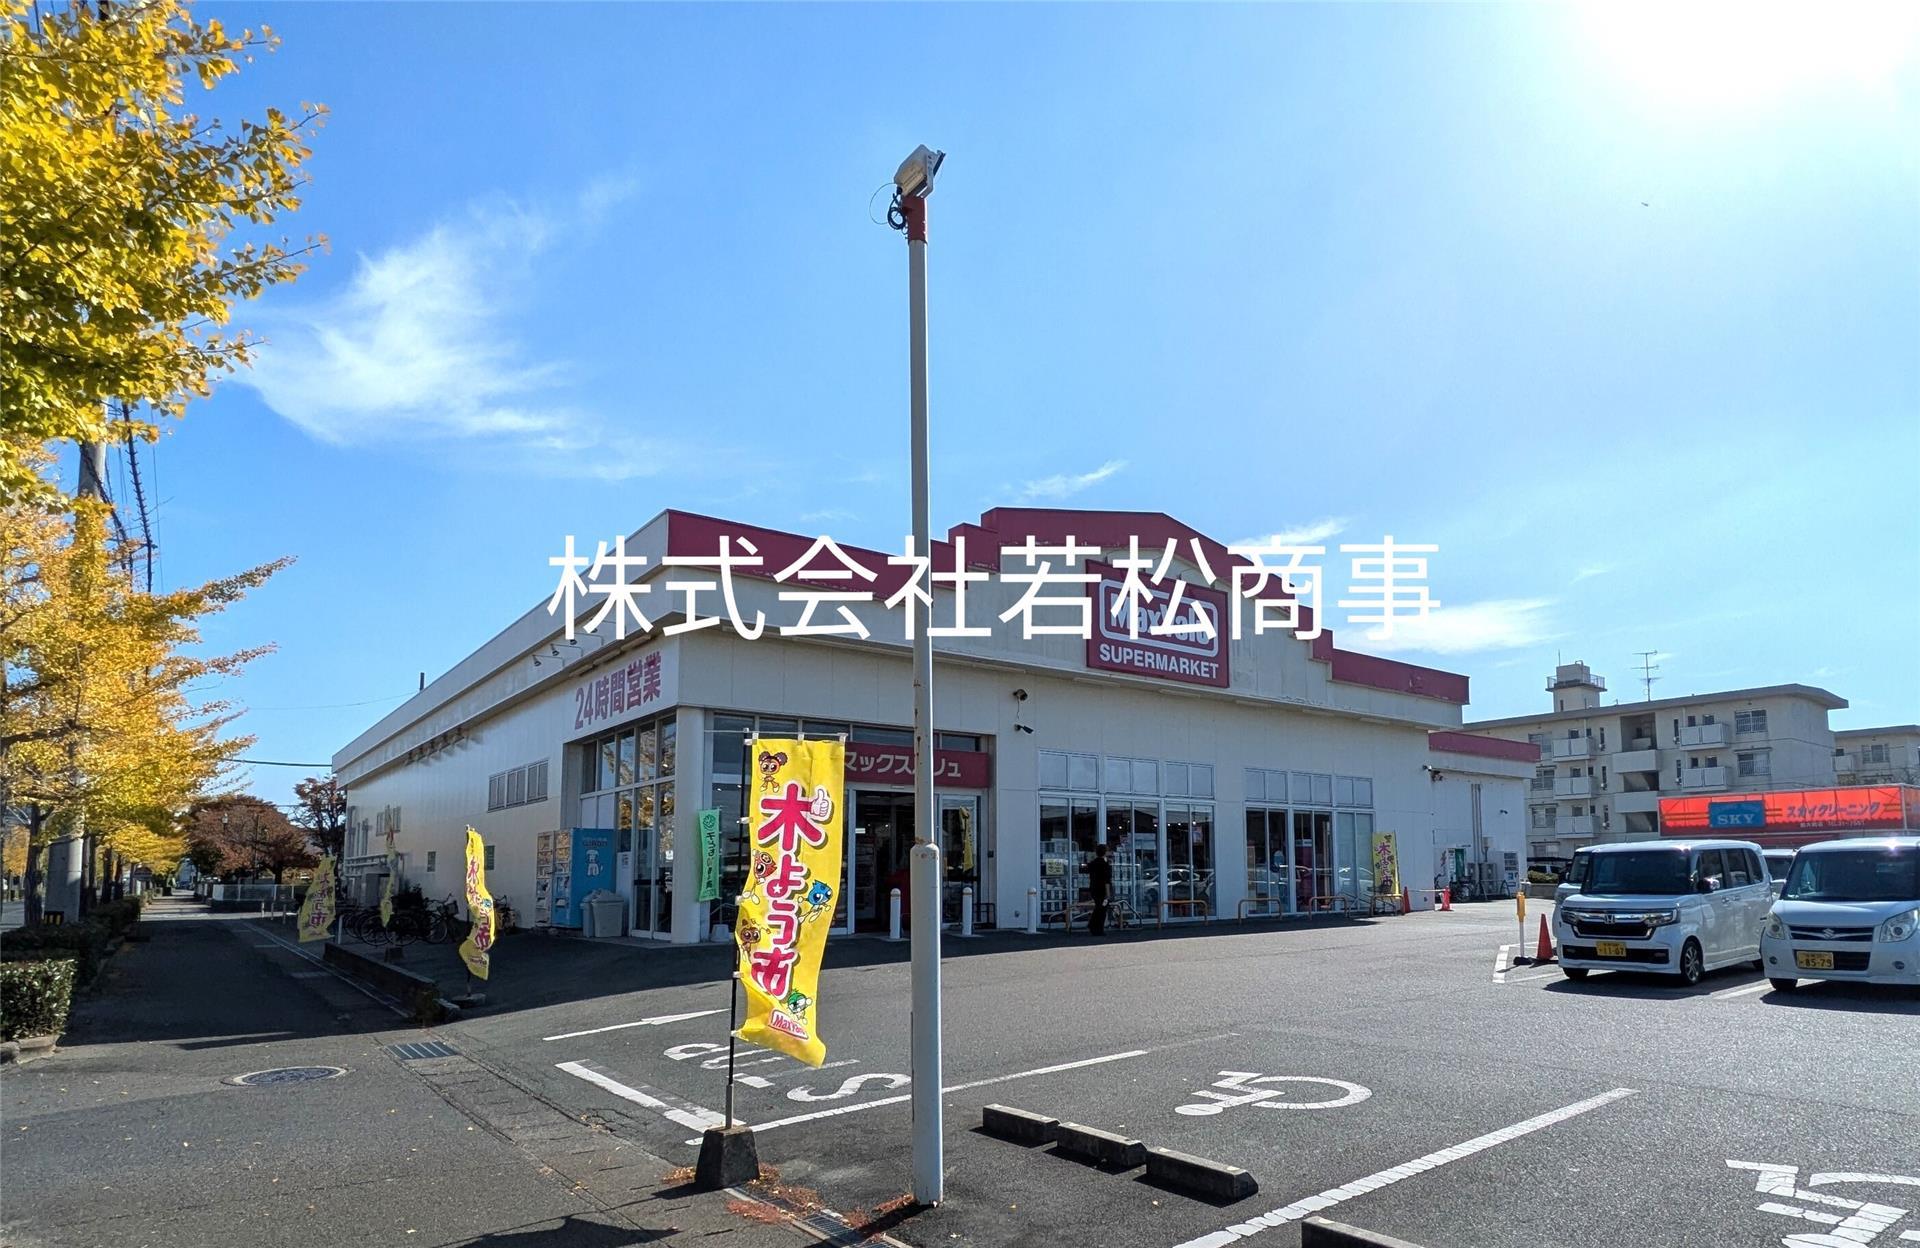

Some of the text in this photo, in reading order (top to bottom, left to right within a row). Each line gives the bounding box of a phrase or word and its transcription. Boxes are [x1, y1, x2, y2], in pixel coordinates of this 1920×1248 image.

[1099, 643, 1219, 679] SUPERMARKET
[575, 651, 662, 730] 24時間営業
[844, 751, 962, 778] マックスリュ
[1717, 813, 1755, 825] SKY
[1787, 802, 1880, 818] スカイクリーニング
[751, 783, 824, 998] 木よう市
